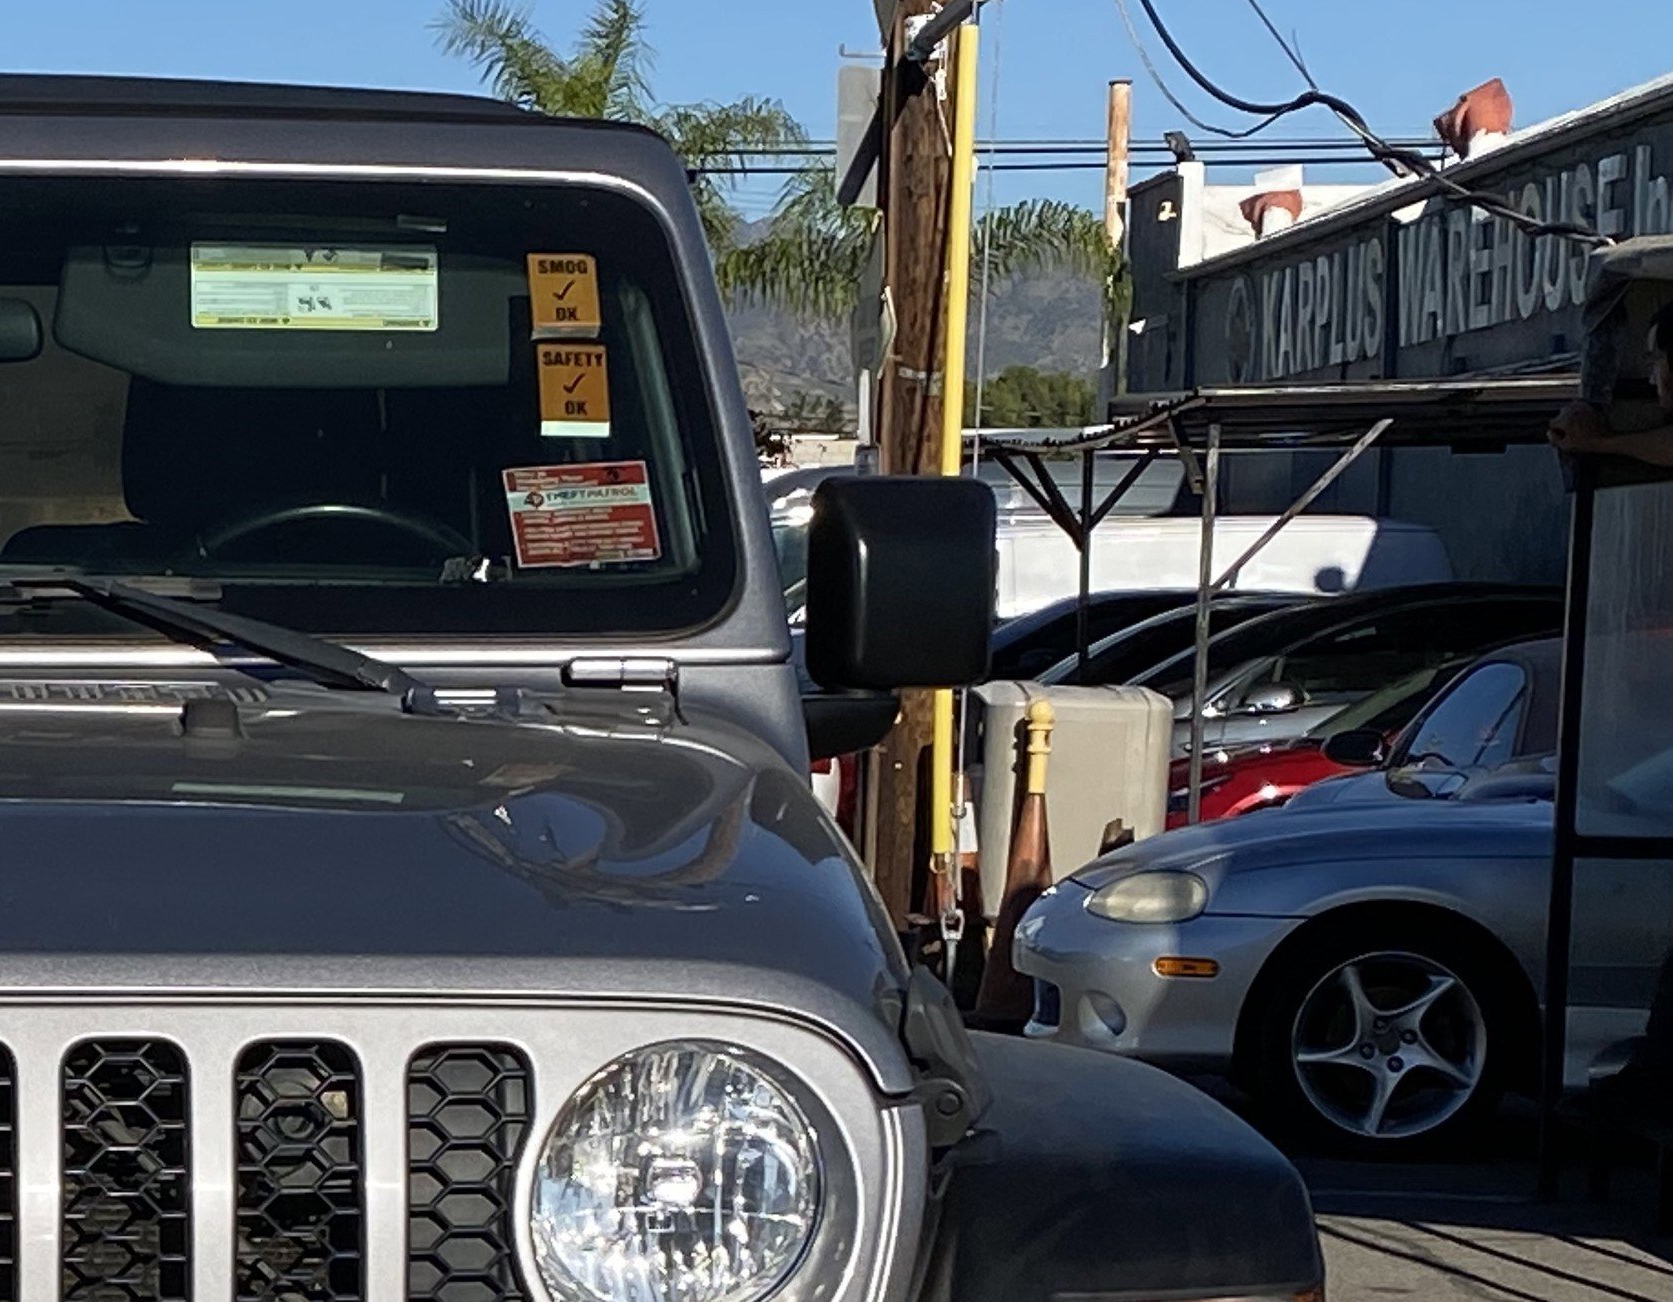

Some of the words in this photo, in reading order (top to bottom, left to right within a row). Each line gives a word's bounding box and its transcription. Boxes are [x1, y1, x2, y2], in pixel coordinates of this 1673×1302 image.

[538, 260, 588, 274] SMOG
[1262, 238, 1384, 380] KARPLUS
[1398, 153, 1627, 347] WAREHOUSE
[555, 307, 578, 321] OK
[543, 351, 603, 367] SAFETY
[564, 400, 588, 415] OK
